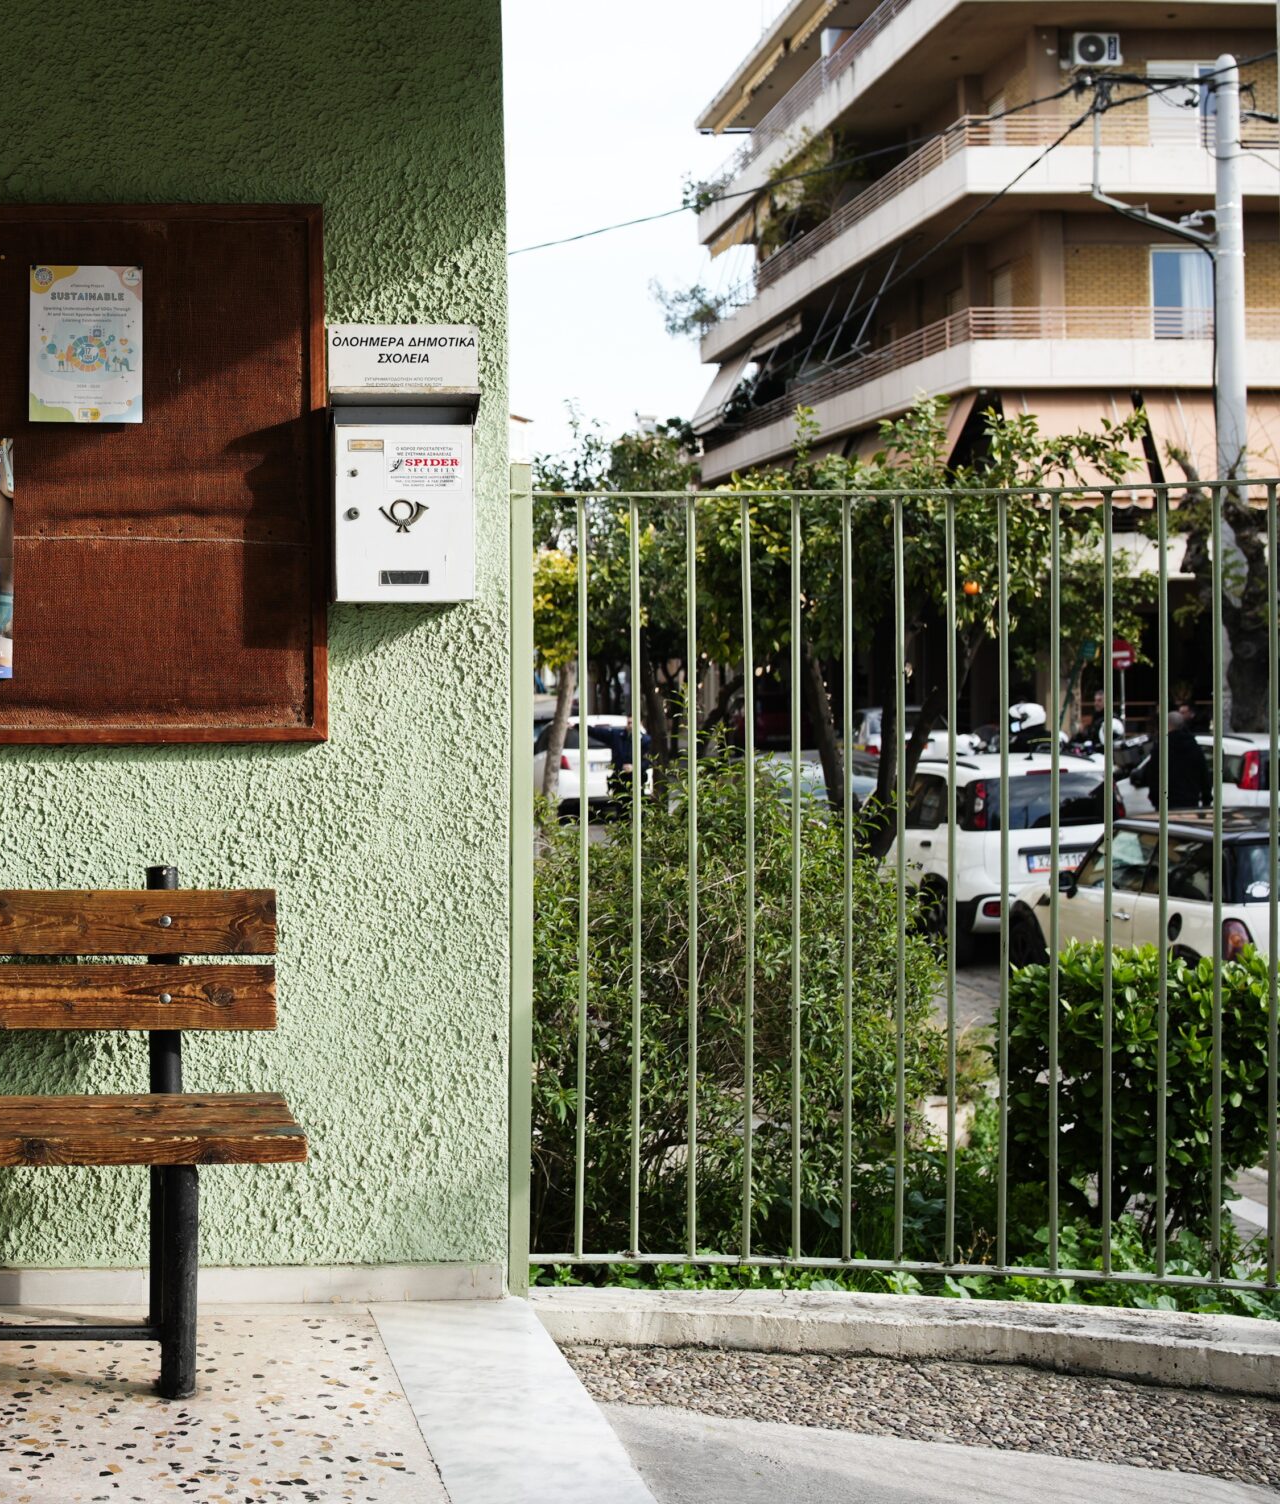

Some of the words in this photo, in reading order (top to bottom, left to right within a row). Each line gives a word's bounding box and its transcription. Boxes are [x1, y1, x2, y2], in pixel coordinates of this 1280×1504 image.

[50, 292, 124, 301] SUSTAINABLE
[332, 336, 404, 347] ΟΛΟΗΜΕΡΑ
[408, 336, 475, 347] ΔΗΜΟΤΙΚΑ
[377, 353, 430, 364] ΣΧΟΛΕΙΑ
[405, 458, 458, 467] SPIDER
